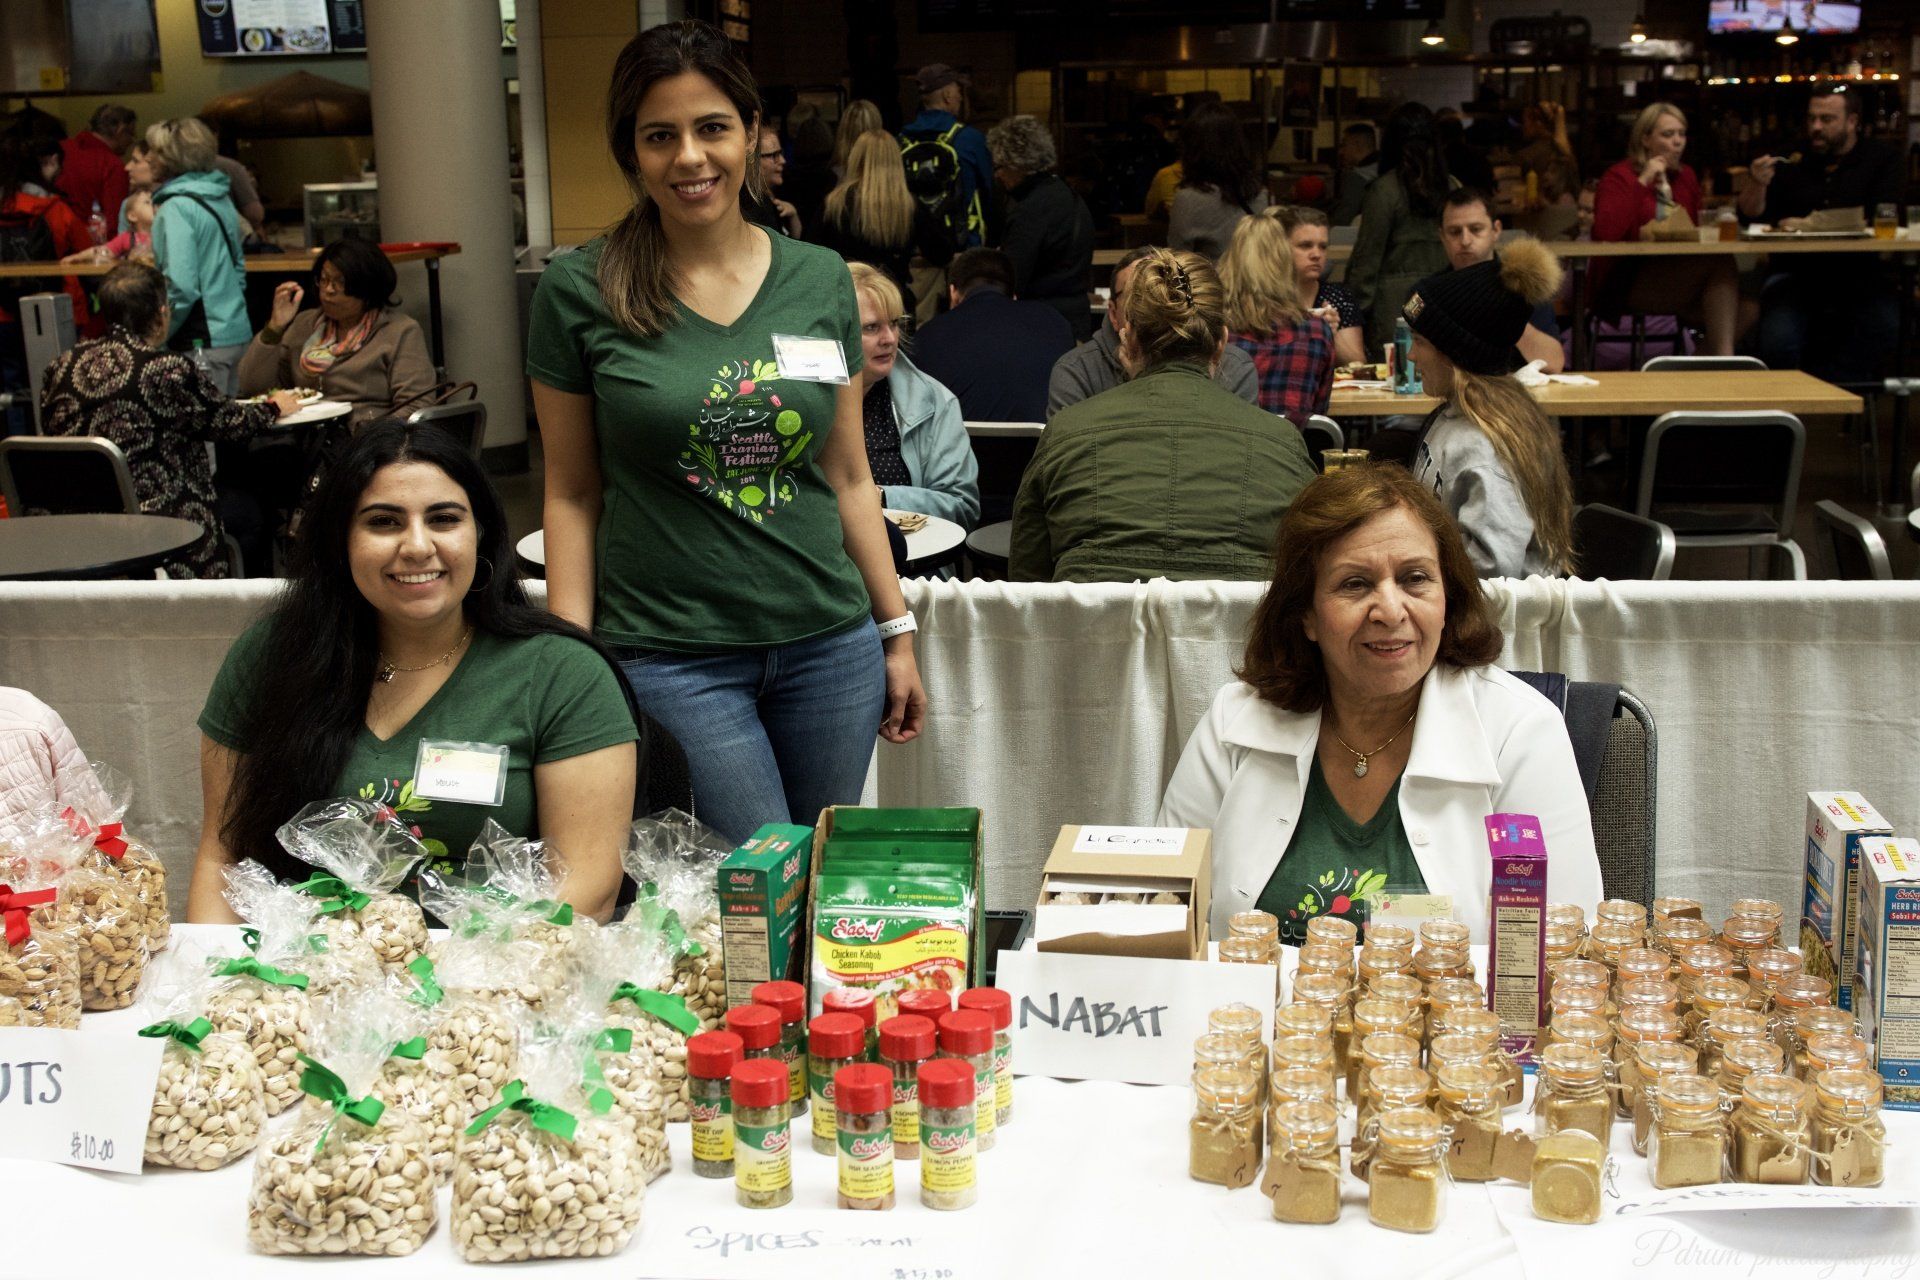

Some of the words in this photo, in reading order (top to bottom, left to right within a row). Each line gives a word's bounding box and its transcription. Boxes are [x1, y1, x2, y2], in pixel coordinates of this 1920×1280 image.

[728, 432, 777, 445] Seattle
[718, 443, 779, 455] Iranian
[722, 453, 778, 467] Festival
[1891, 902, 1910, 911] HERB
[1892, 912, 1910, 920] Sabzi
[831, 948, 858, 960] Chicken
[859, 949, 882, 960] Kabob
[838, 958, 874, 971] Seasoning
[1020, 992, 1168, 1038] NABAT
[70, 1131, 115, 1161] $10.00
[850, 1132, 891, 1156] Sadaf
[928, 1128, 970, 1151] Sadaf
[684, 1225, 824, 1258] SPICES
